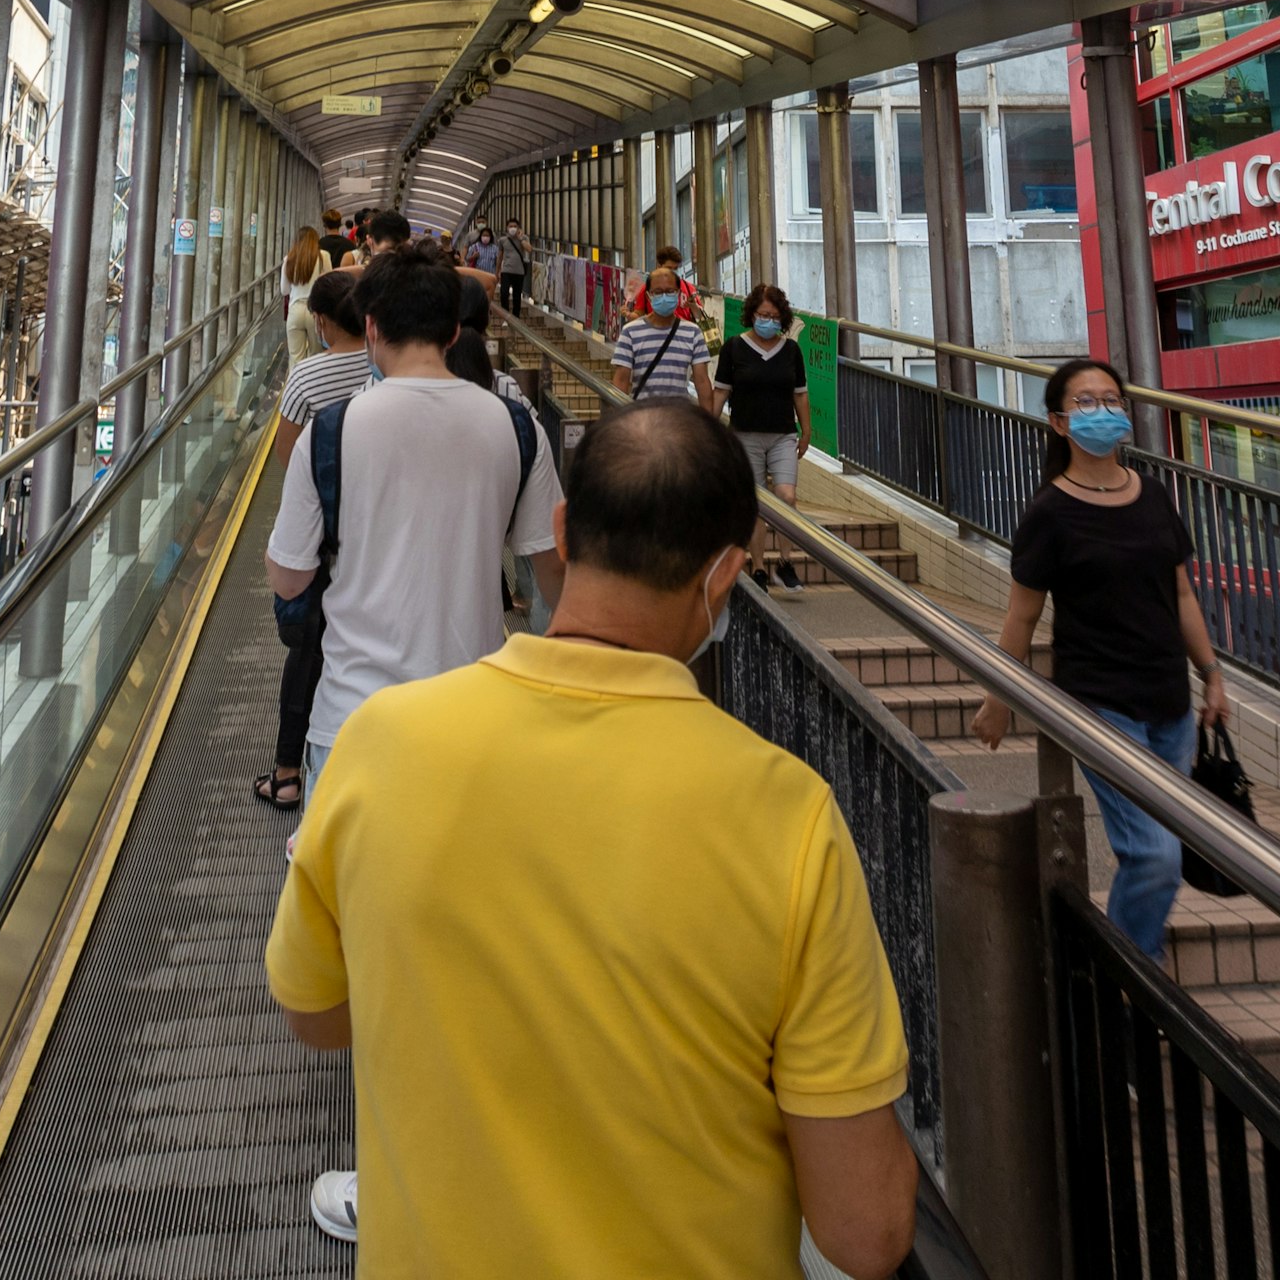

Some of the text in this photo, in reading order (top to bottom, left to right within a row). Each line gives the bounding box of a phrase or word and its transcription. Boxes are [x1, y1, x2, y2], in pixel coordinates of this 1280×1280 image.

[1196, 236, 1218, 255] 9-11
[1219, 228, 1268, 249] Cochrane
[809, 323, 831, 347] GREEN
